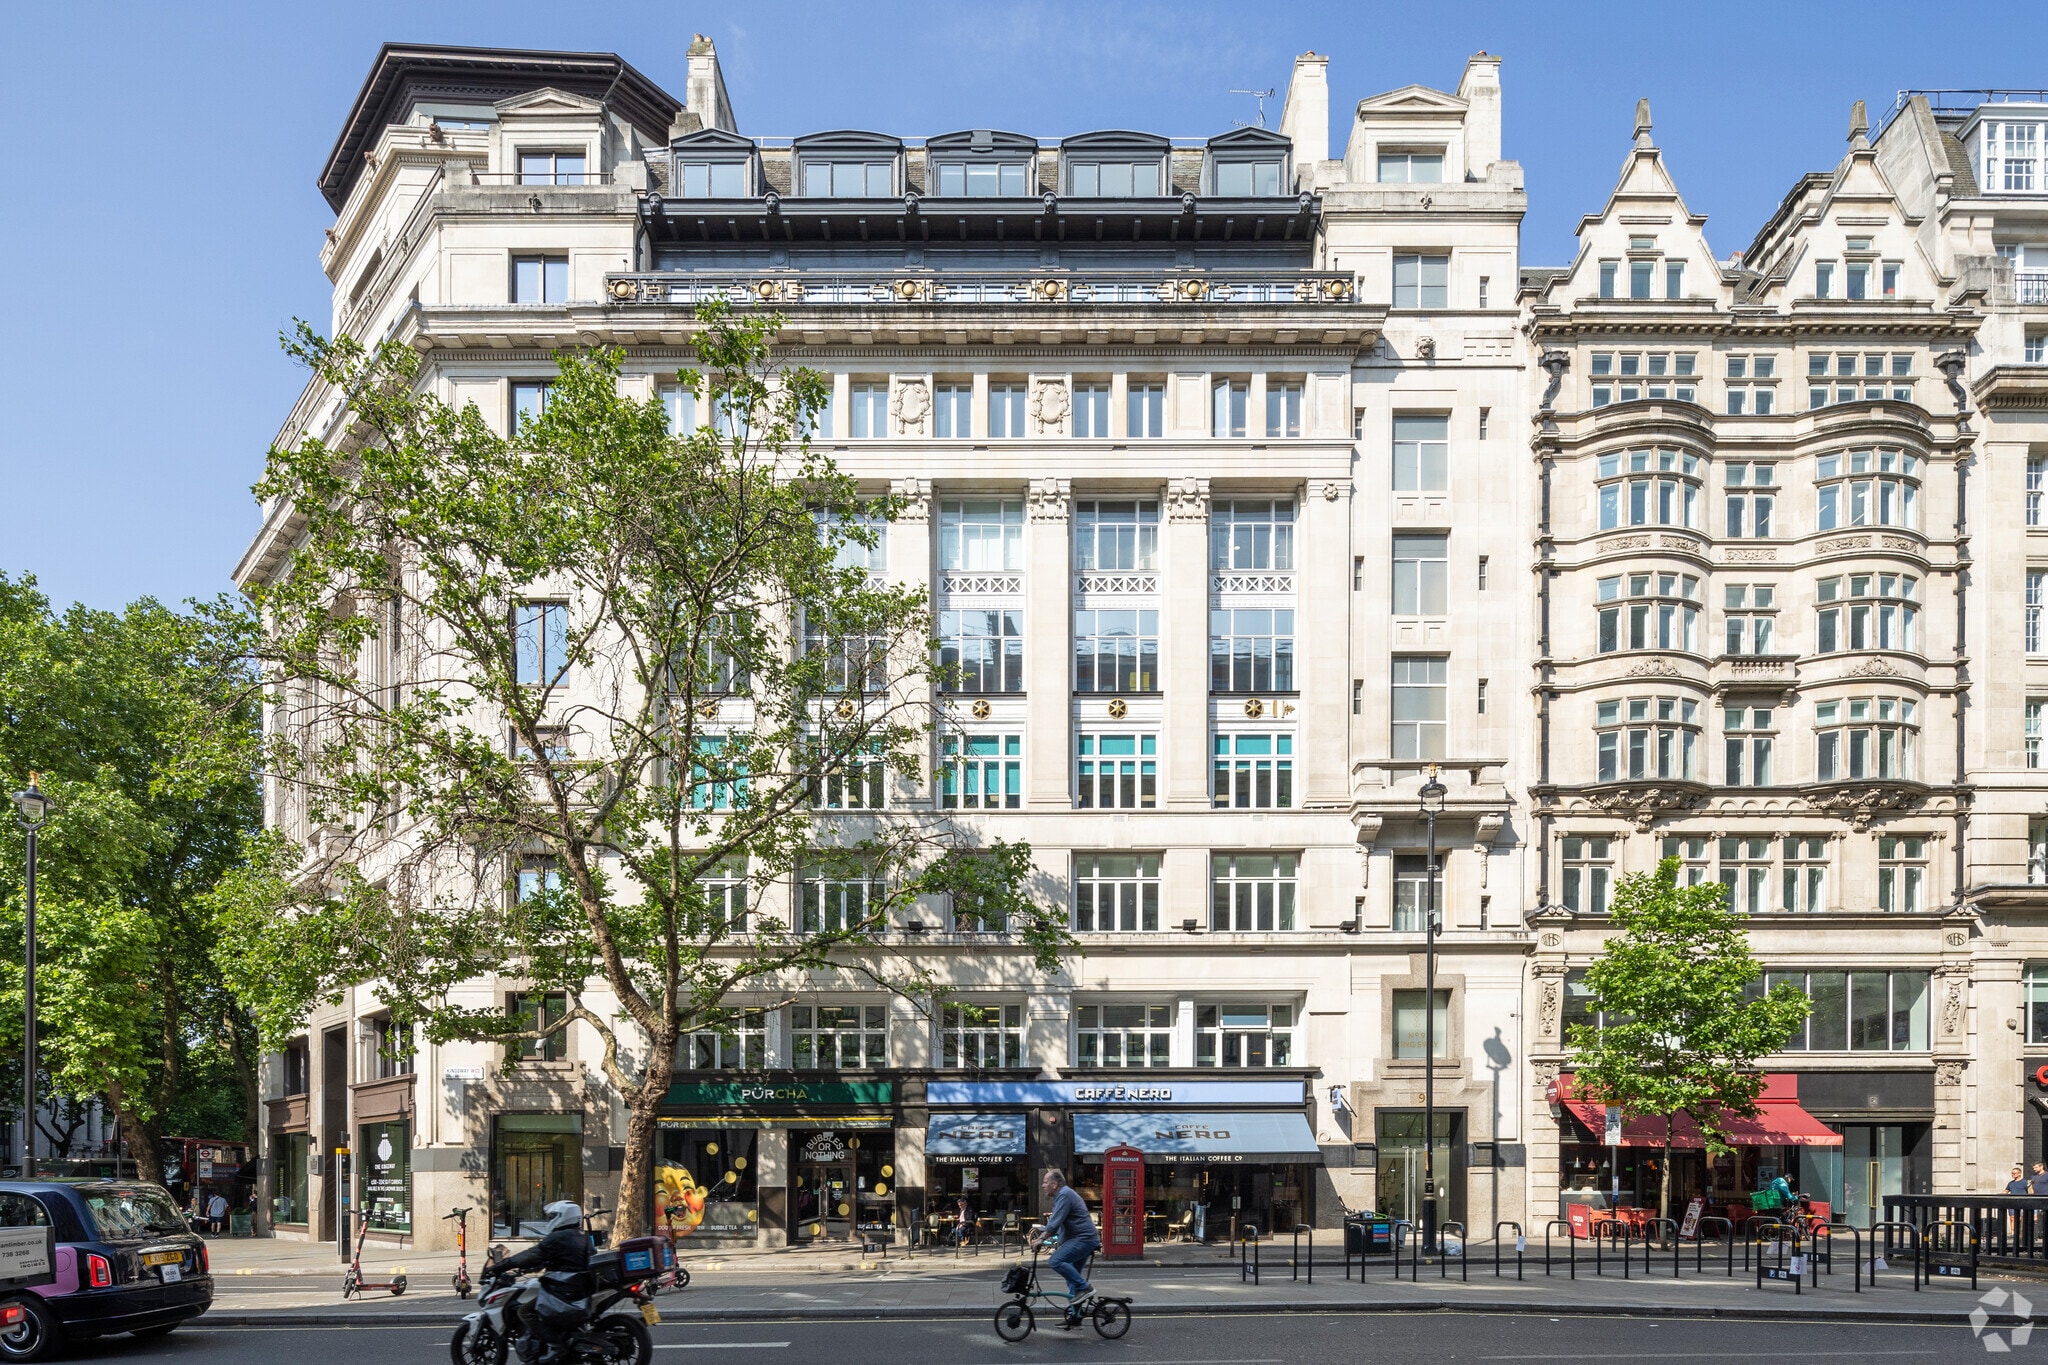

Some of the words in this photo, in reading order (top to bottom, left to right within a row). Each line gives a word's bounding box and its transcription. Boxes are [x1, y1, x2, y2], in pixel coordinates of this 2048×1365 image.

[1394, 1040, 1439, 1048] KINGSWY
[1126, 1088, 1172, 1101] NERO
[1418, 1093, 1426, 1104] 9
[938, 1130, 1014, 1140] NERO
[1155, 1130, 1231, 1140] NERO
[806, 1133, 844, 1151] BUBBLES
[818, 1142, 831, 1151] OR
[805, 1151, 845, 1160] NOTHING
